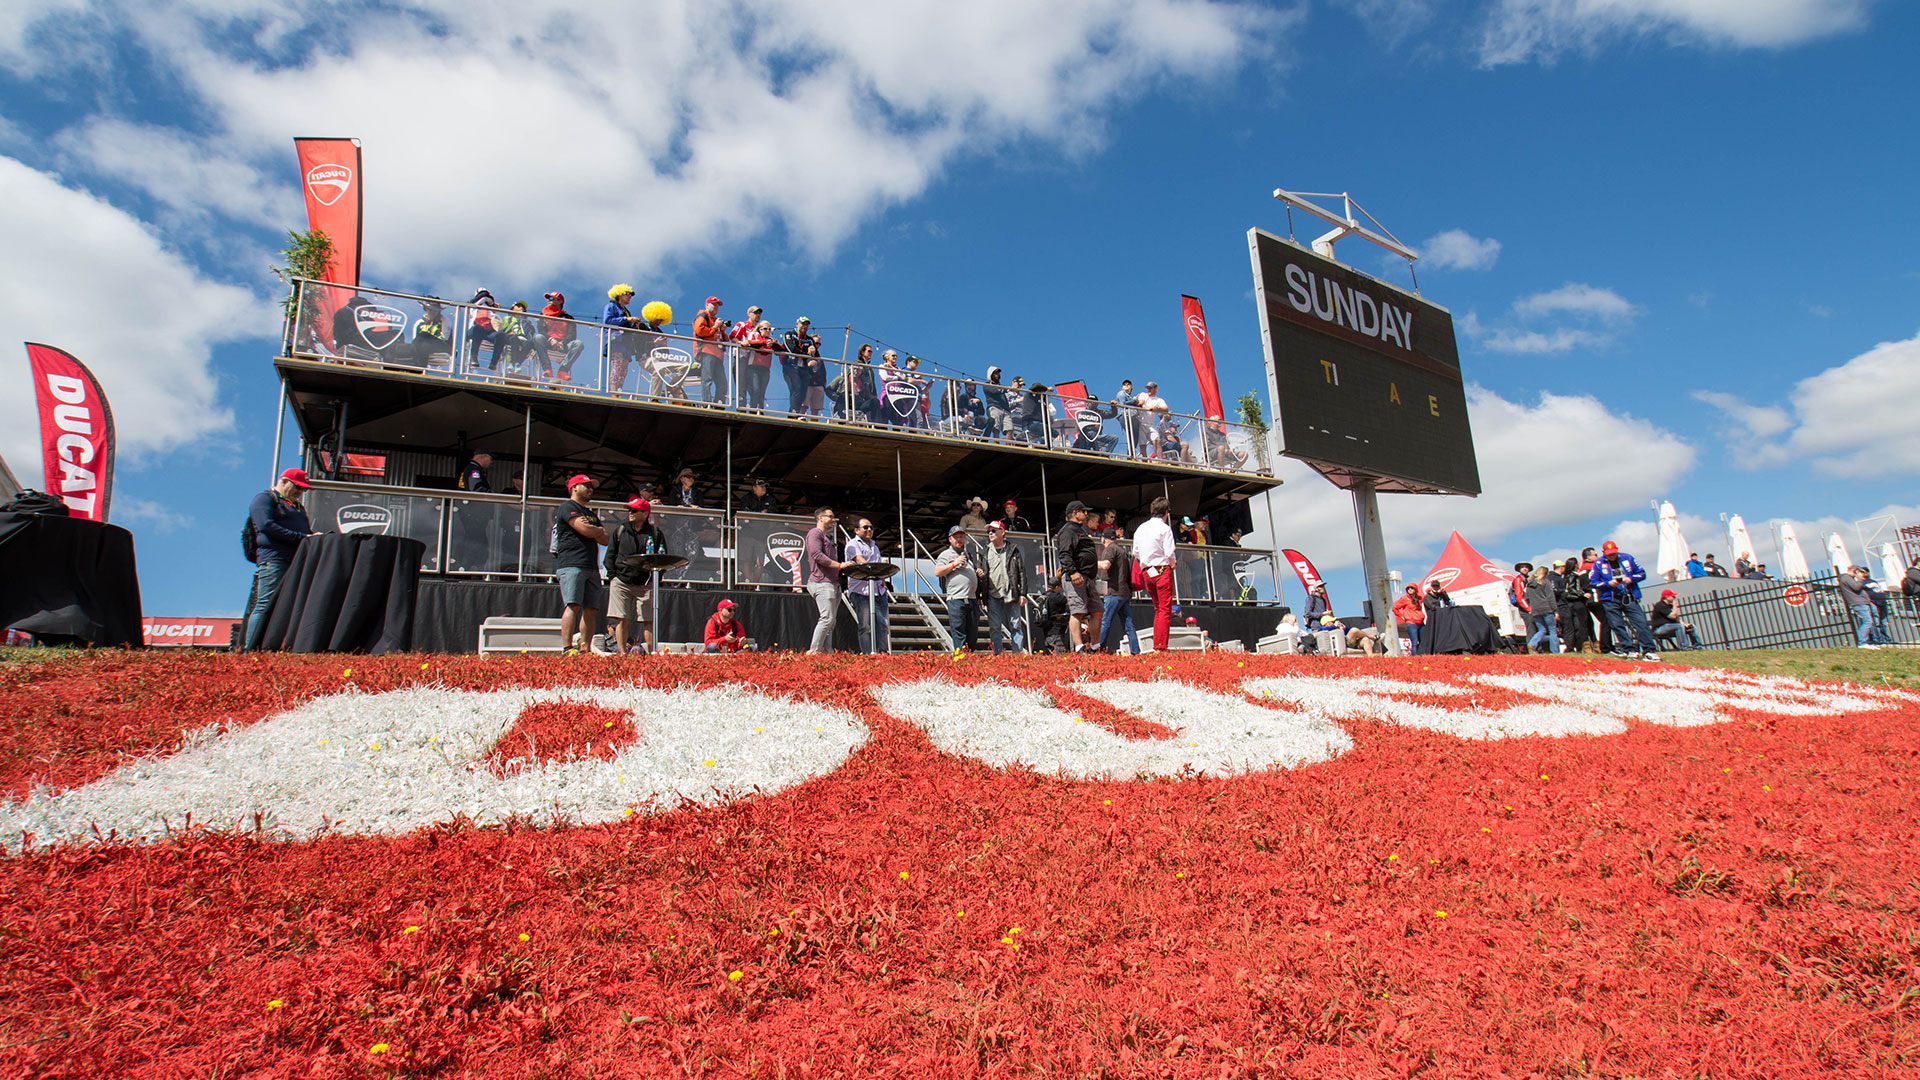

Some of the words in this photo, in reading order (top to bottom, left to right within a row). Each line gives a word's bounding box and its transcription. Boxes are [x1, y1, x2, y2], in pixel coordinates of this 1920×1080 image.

[1285, 263, 1413, 351] SUNDAY
[360, 310, 402, 322] DUCATI
[655, 351, 688, 362] DUCATI
[889, 385, 915, 395] DUCATI
[1390, 382, 1401, 405] A
[1428, 394, 1440, 417] E
[343, 511, 387, 521] DUCATI
[771, 538, 801, 546] DUCATI
[142, 623, 214, 637] DUCATI
